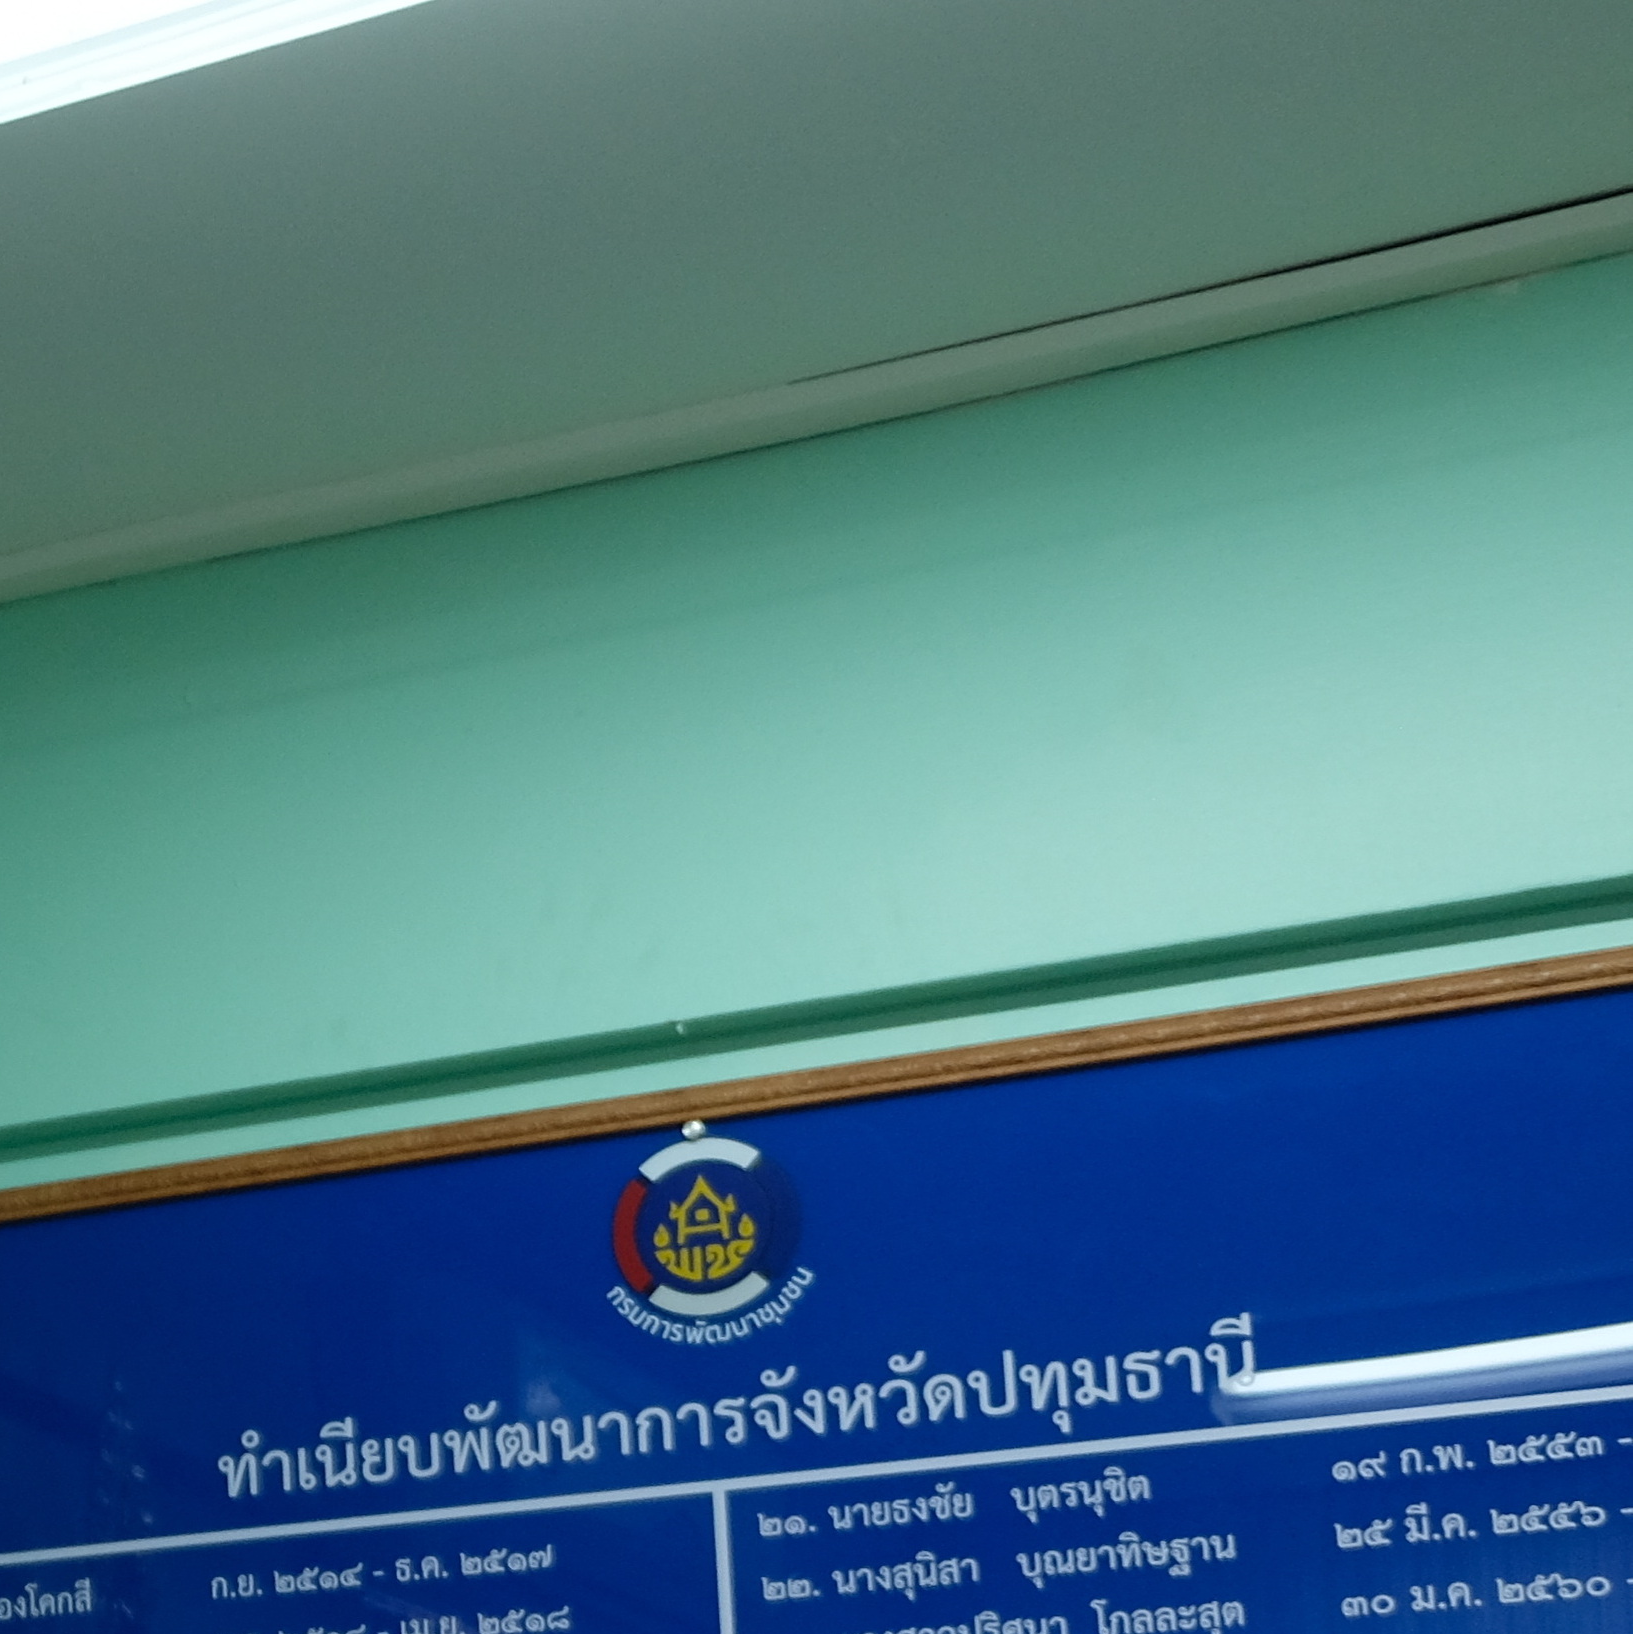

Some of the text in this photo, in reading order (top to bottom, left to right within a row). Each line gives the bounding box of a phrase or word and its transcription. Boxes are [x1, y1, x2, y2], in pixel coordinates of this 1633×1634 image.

[606, 1266, 816, 1345] กรมการพัฒนาชุมชน
[218, 1313, 1259, 1498] ทำเนียบพัฒนาการจังหวัดปทุมธานี
[1331, 1430, 1605, 1483] ๑๙ ก.พ. ๒๕๕๓
[756, 1466, 1152, 1538] ๒๑. นายธงชัย บุตรนุชิต
[1333, 1500, 1608, 1550] ๒๕ มี.ค. ๒๕๕๖
[210, 1543, 554, 1600] ก.ย. ๒๕๑๔ ธ.ค. ๒๕๑๗
[760, 1576, 822, 1602] ๒๒.
[831, 1550, 981, 1601] นางสุนิสา
[1340, 1572, 1613, 1618] ๓๐ ม.ค. ๒๕๖๐
